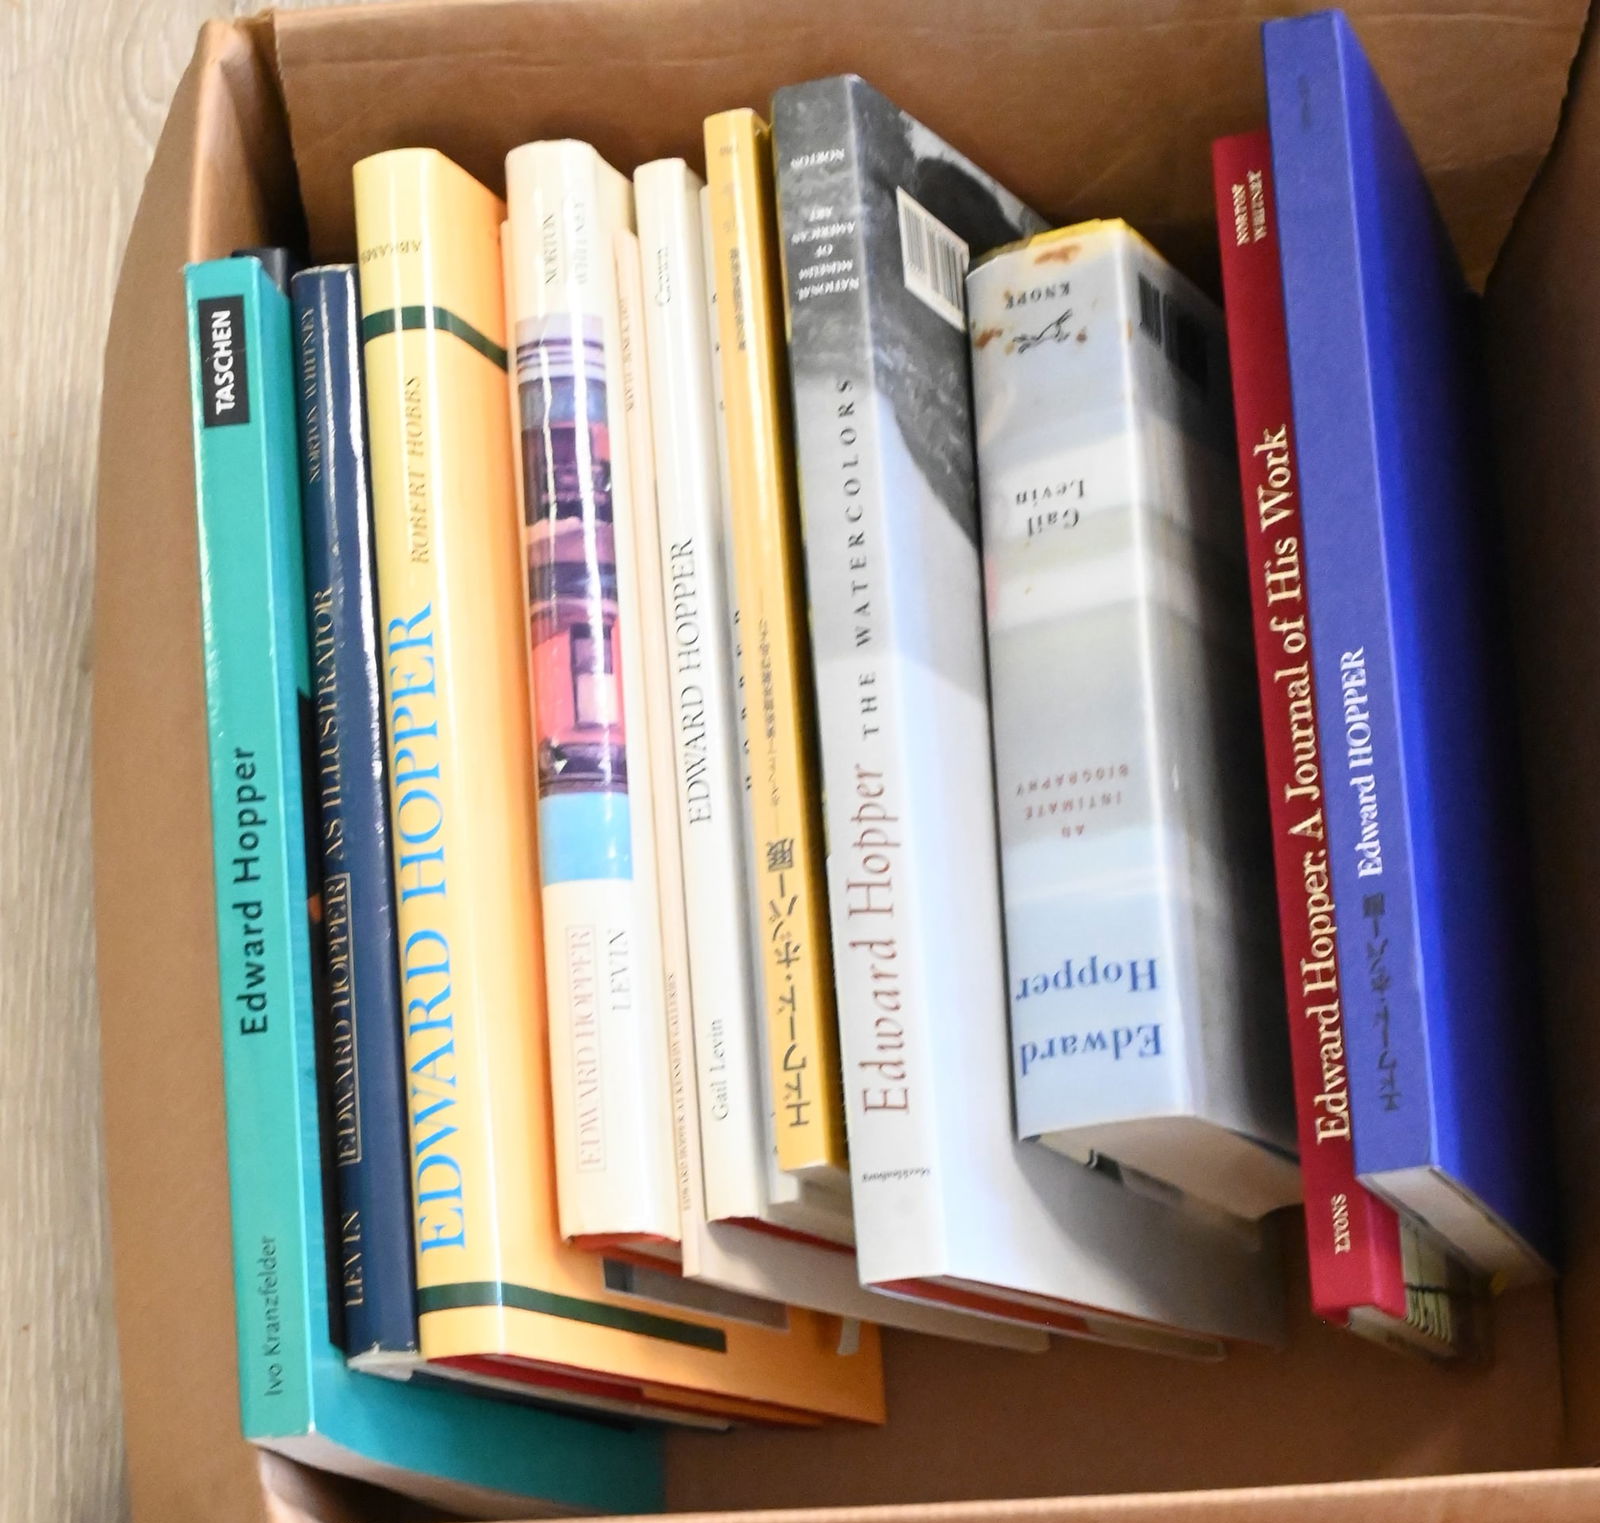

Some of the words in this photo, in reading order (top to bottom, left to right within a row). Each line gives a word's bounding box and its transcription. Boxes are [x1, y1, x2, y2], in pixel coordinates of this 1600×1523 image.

[541, 213, 562, 287] NORTON
[1231, 183, 1251, 248] NORTON
[1247, 169, 1267, 243] WHITNEY
[1004, 281, 1072, 310] KNOPF
[210, 309, 236, 416] TASCHEN
[300, 306, 319, 401] WHITNEY
[305, 404, 323, 485] NORTON
[404, 375, 426, 459] HOBBS
[407, 465, 431, 565] ROBERT
[835, 379, 874, 649] WATERCOLORS
[1015, 478, 1086, 506] Levin
[1026, 508, 1080, 537] Gail
[1253, 423, 1295, 533] Work
[669, 536, 701, 674] HOPPER
[1264, 536, 1303, 608] His
[1269, 614, 1308, 655] of
[313, 585, 344, 811] ILLUSTRATOR
[858, 671, 881, 741] THE
[1274, 660, 1321, 802] Journal
[1339, 645, 1374, 771] HOPPER
[388, 600, 447, 906] HOPPER
[680, 684, 713, 826] EDWARD
[1015, 763, 1130, 797] BIOGRAPHY
[231, 746, 267, 886] Hopper
[324, 816, 344, 862] AS
[845, 763, 902, 919] Hopper
[1024, 791, 1123, 821] INTIMATE
[1287, 807, 1326, 839] A
[1349, 772, 1384, 879] Edward
[232, 899, 268, 1037] Edward
[325, 879, 350, 1013] HOPPER
[606, 927, 632, 1012] LEVIN
[1302, 850, 1341, 1000] Hopper:
[570, 927, 596, 1040] HOPPER
[765, 837, 812, 1128] エドワード・ホッパー展
[849, 936, 911, 1116] Edward
[1015, 955, 1159, 1000] Hopper
[331, 1017, 357, 1160] EDWARD
[405, 928, 466, 1254] EDWARD
[708, 1017, 727, 1073] Levin
[1019, 1023, 1164, 1077] Edward
[1305, 998, 1352, 1145] Edward
[576, 1042, 602, 1170] EDWARD
[710, 1077, 729, 1122] Gail
[342, 1210, 364, 1307] LEVIN
[1330, 1192, 1352, 1256] LYONS
[256, 1234, 283, 1359] Kranzfelder
[264, 1363, 285, 1397] Ivo
